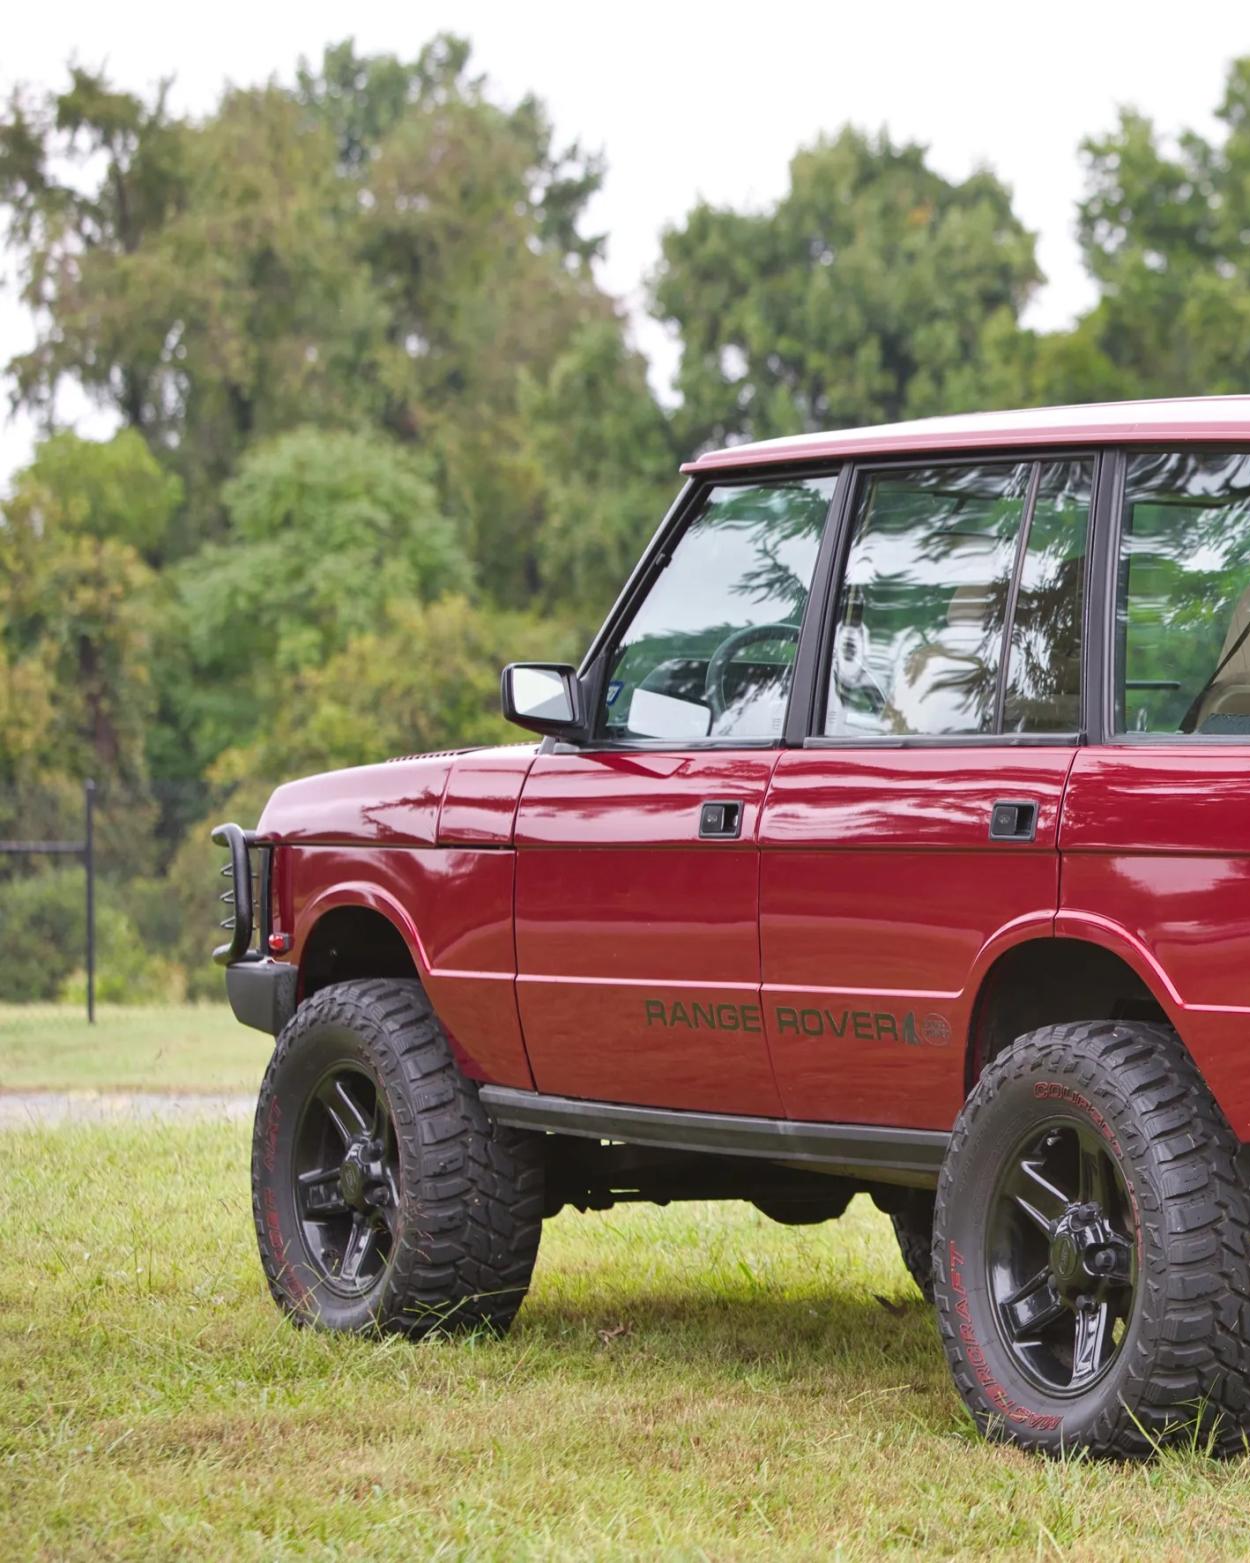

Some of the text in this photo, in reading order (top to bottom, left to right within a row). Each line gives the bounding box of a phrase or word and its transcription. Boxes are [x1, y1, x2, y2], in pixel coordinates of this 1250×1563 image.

[645, 999, 761, 1033] RANGE
[776, 1006, 899, 1042] ROVER
[949, 1240, 1065, 1431] MASTERCRAFT
